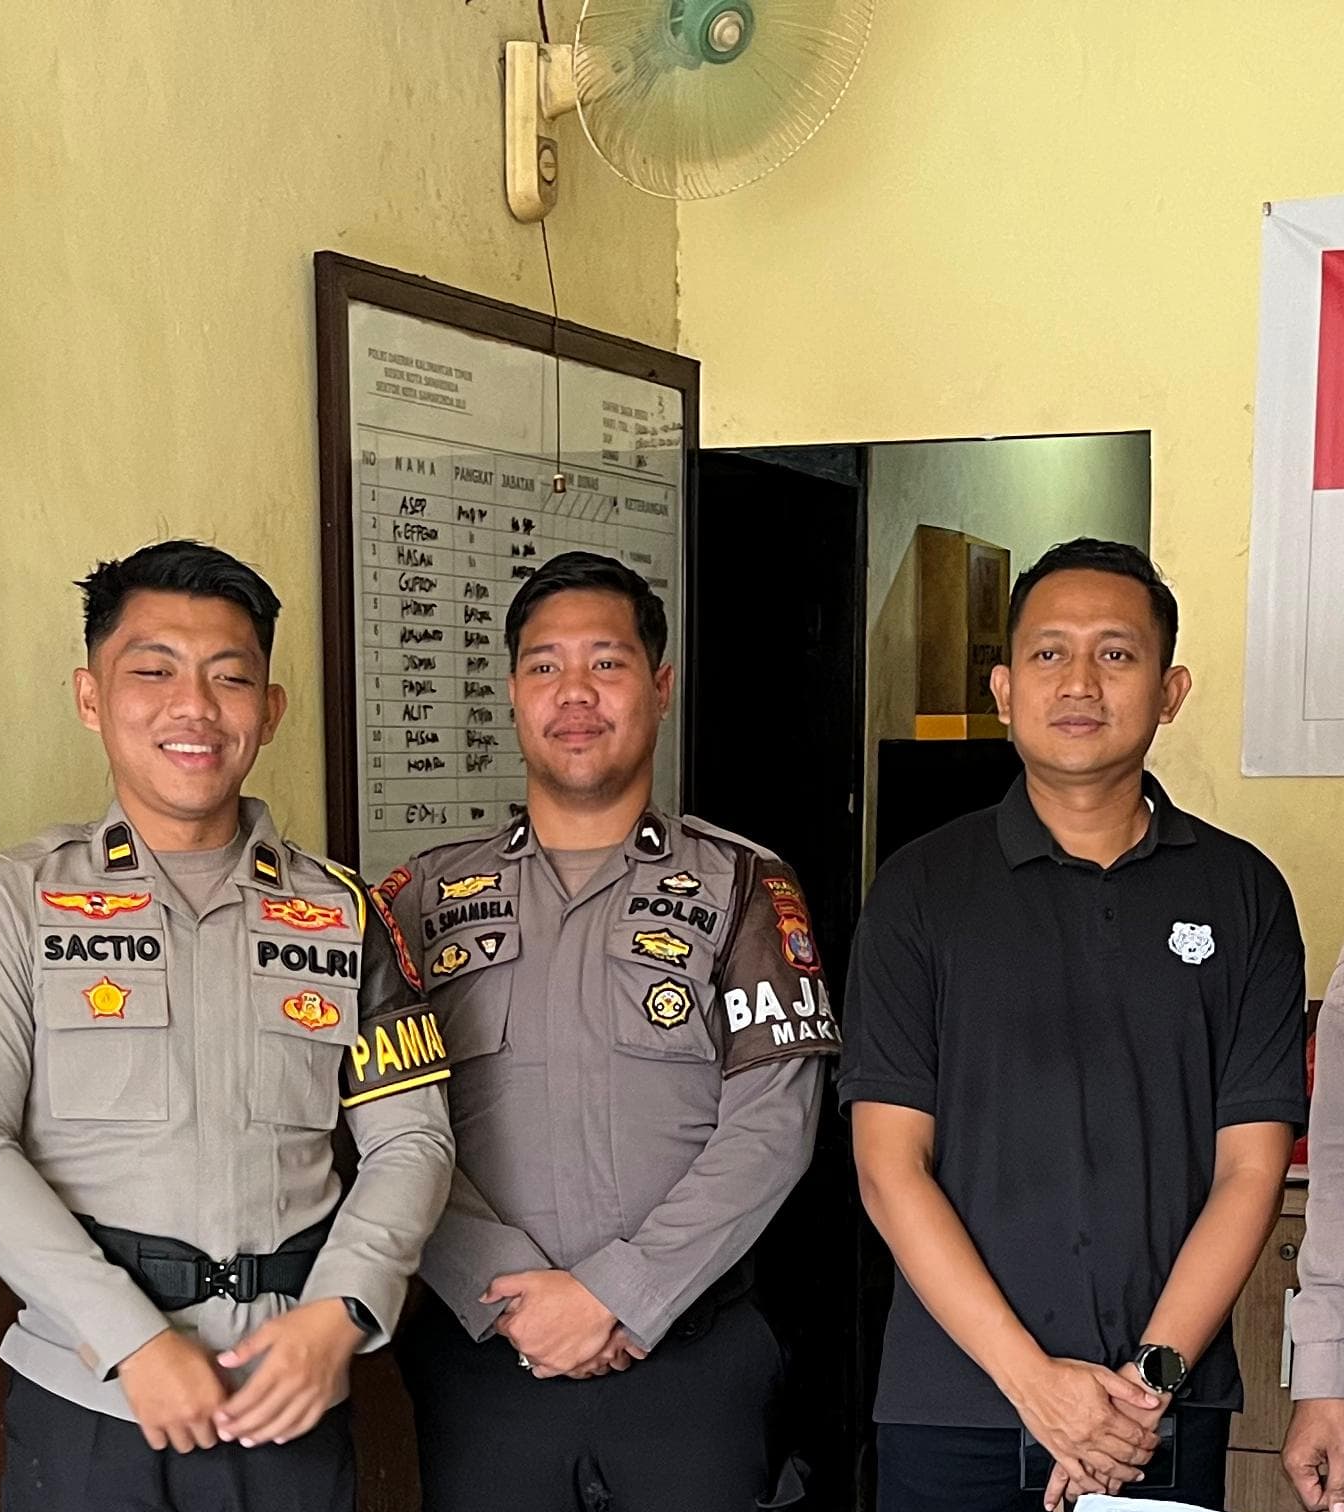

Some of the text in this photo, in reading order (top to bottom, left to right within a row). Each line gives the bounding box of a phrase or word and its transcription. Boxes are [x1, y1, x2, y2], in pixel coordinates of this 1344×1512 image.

[362, 450, 376, 466] NO
[454, 466, 494, 486] PANGKAT
[371, 488, 376, 502] 1
[371, 516, 377, 529] 2
[397, 545, 433, 567] HASAN
[374, 782, 383, 794] 12
[628, 897, 717, 935] POLRI
[44, 934, 160, 963] SACTIO
[258, 940, 357, 980] POLRI
[771, 1020, 843, 1046] MAK
